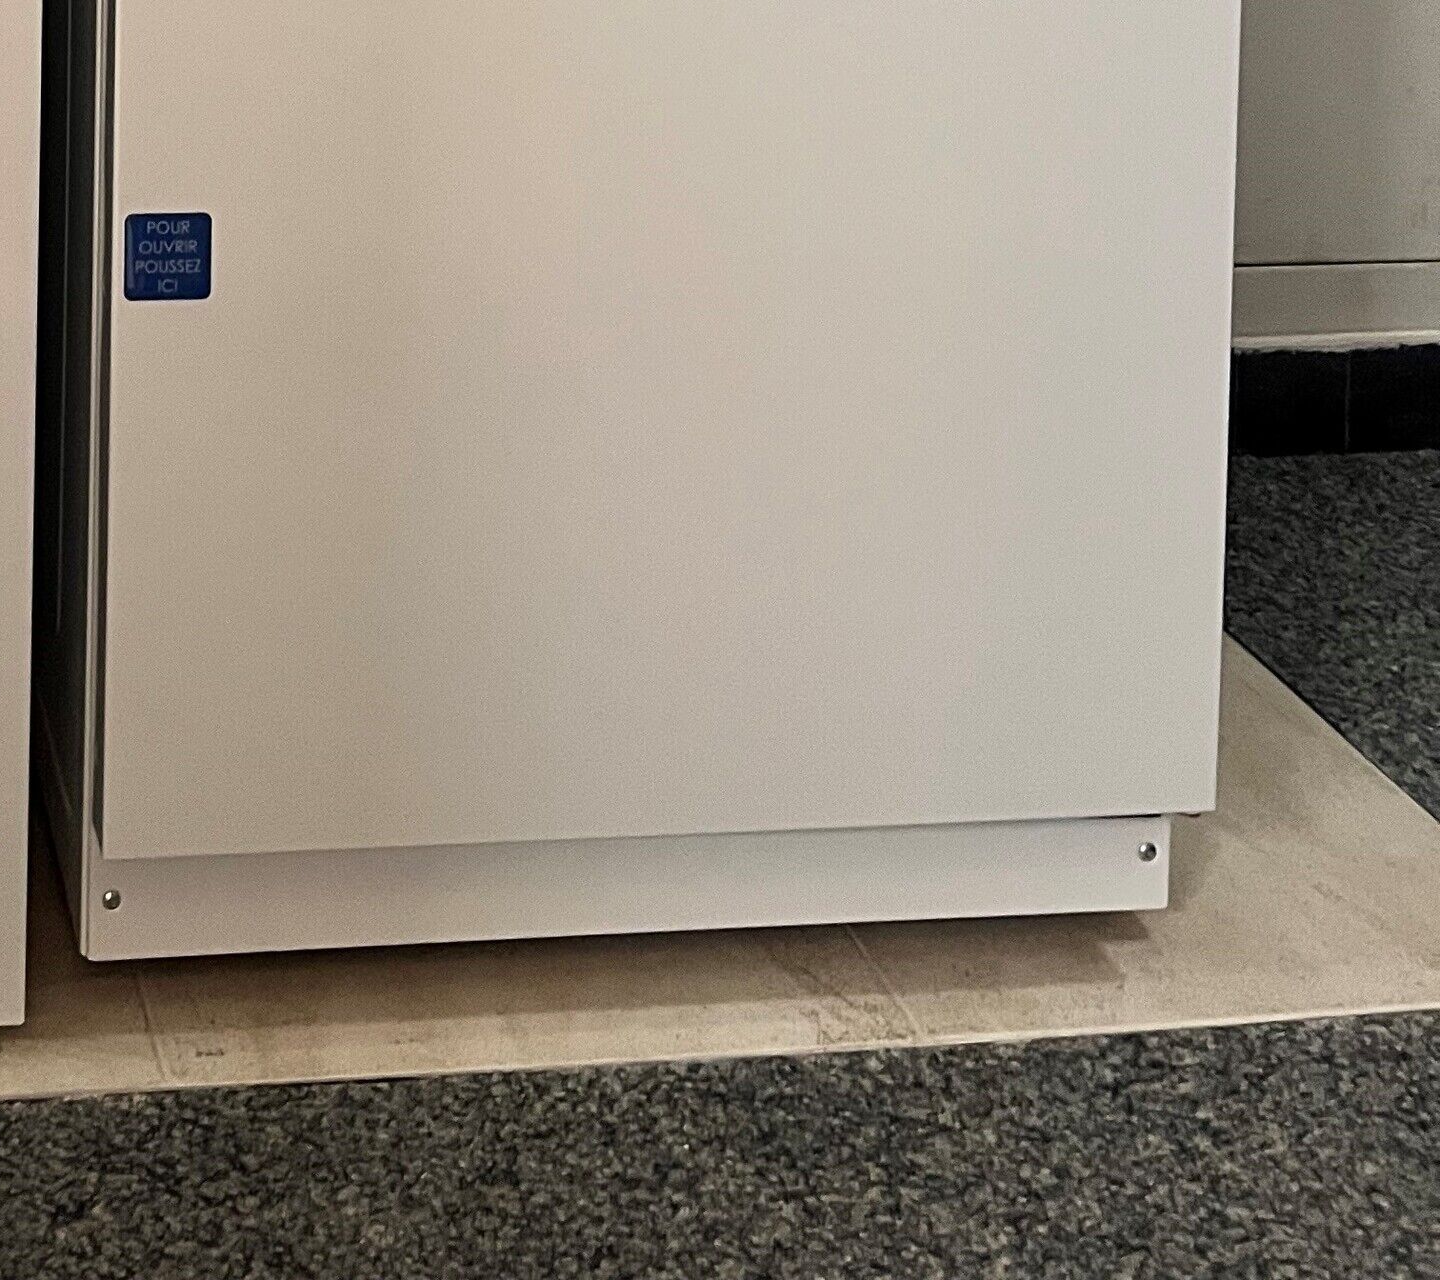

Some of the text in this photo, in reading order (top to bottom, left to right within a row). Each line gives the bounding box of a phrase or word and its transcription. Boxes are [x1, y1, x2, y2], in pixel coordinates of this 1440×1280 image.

[146, 221, 190, 234] POUR
[139, 240, 198, 254] OUVRIR
[134, 259, 201, 274] POUSSEZ
[157, 279, 178, 293] ICI
